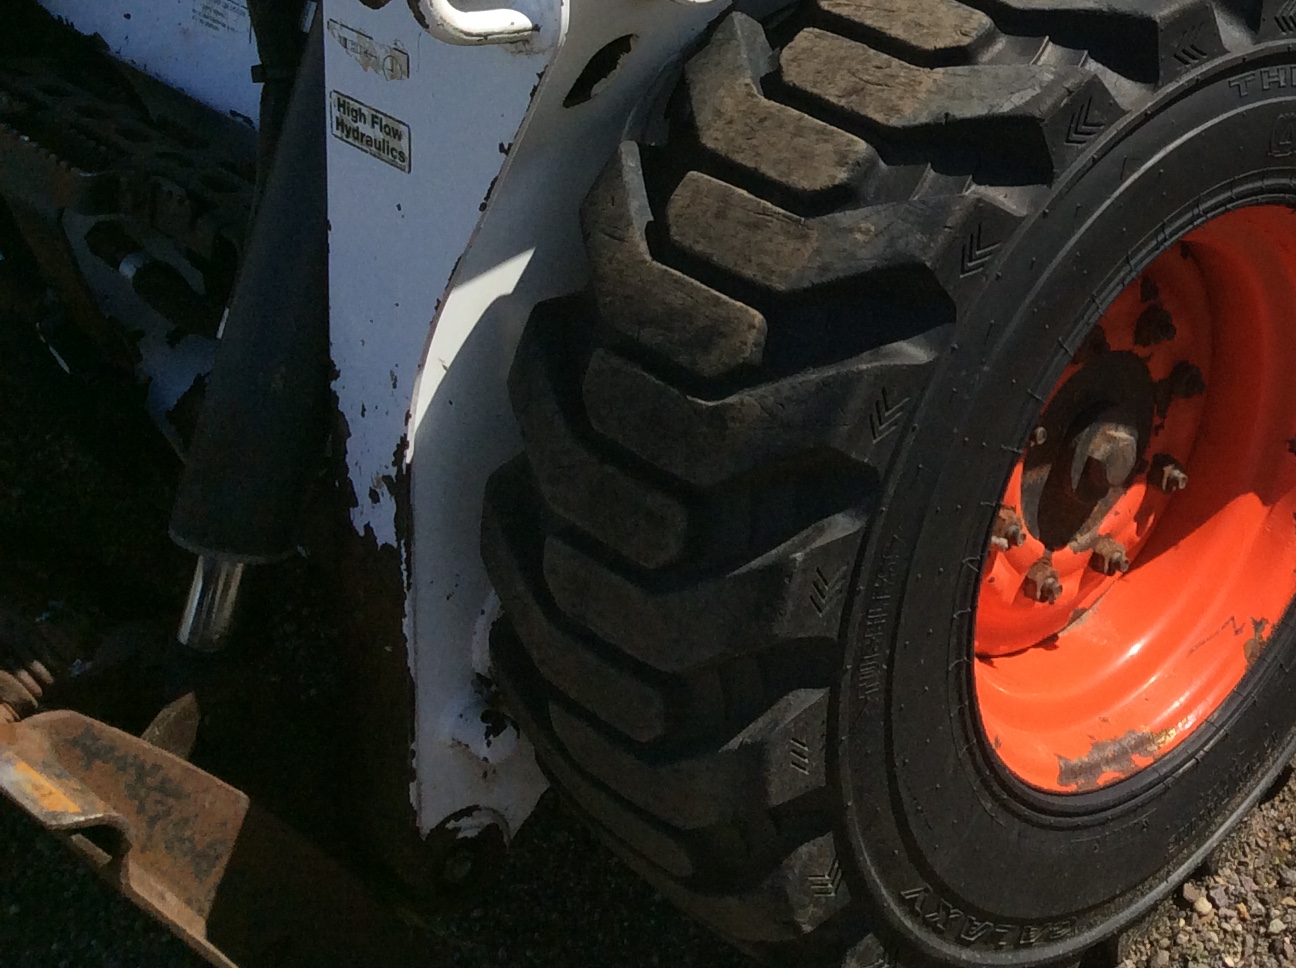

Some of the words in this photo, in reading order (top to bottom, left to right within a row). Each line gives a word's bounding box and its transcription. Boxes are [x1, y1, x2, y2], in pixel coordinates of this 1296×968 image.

[335, 115, 406, 164] Hydraulics
[337, 97, 366, 125] High
[371, 113, 402, 142] Flow
